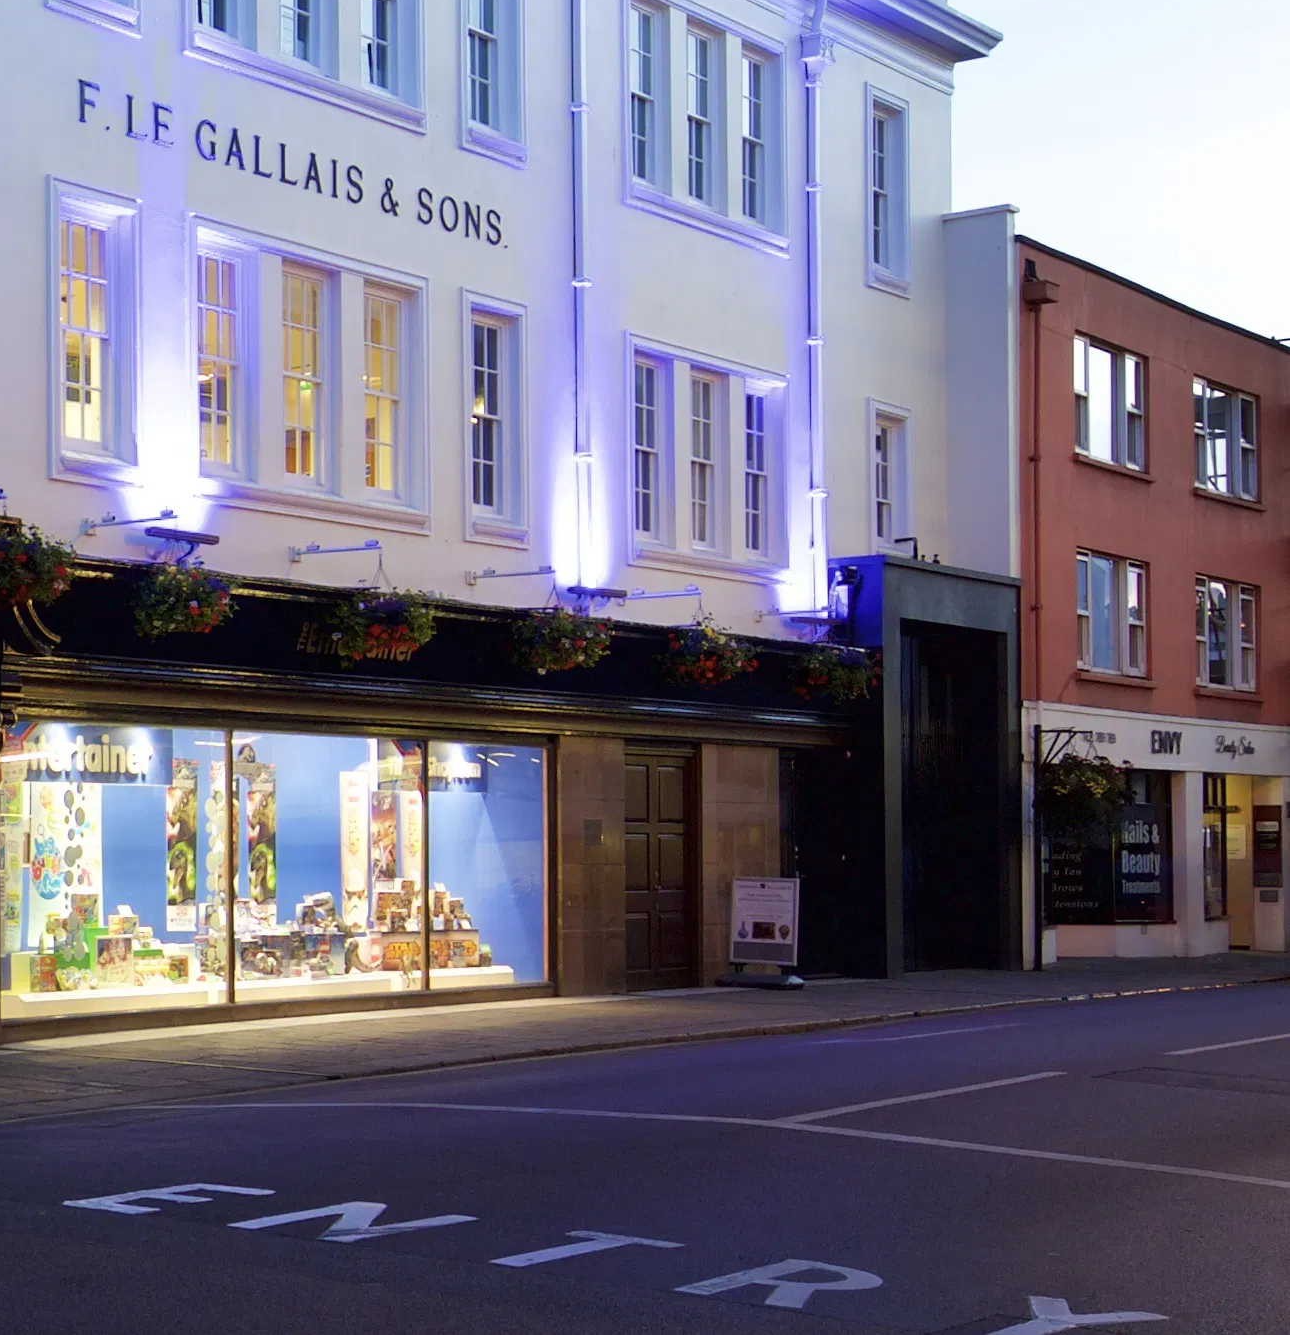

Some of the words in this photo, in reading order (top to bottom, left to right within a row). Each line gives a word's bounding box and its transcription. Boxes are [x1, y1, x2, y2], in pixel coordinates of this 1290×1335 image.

[125, 94, 174, 148] LE
[194, 119, 364, 204] GALLAIS
[380, 177, 400, 217] &
[1150, 729, 1183, 756] ENVY
[1151, 823, 1160, 844] &
[1121, 849, 1161, 876] Beauty
[1122, 879, 1161, 894] Treatments
[62, 1182, 1171, 1335] ENTRY
